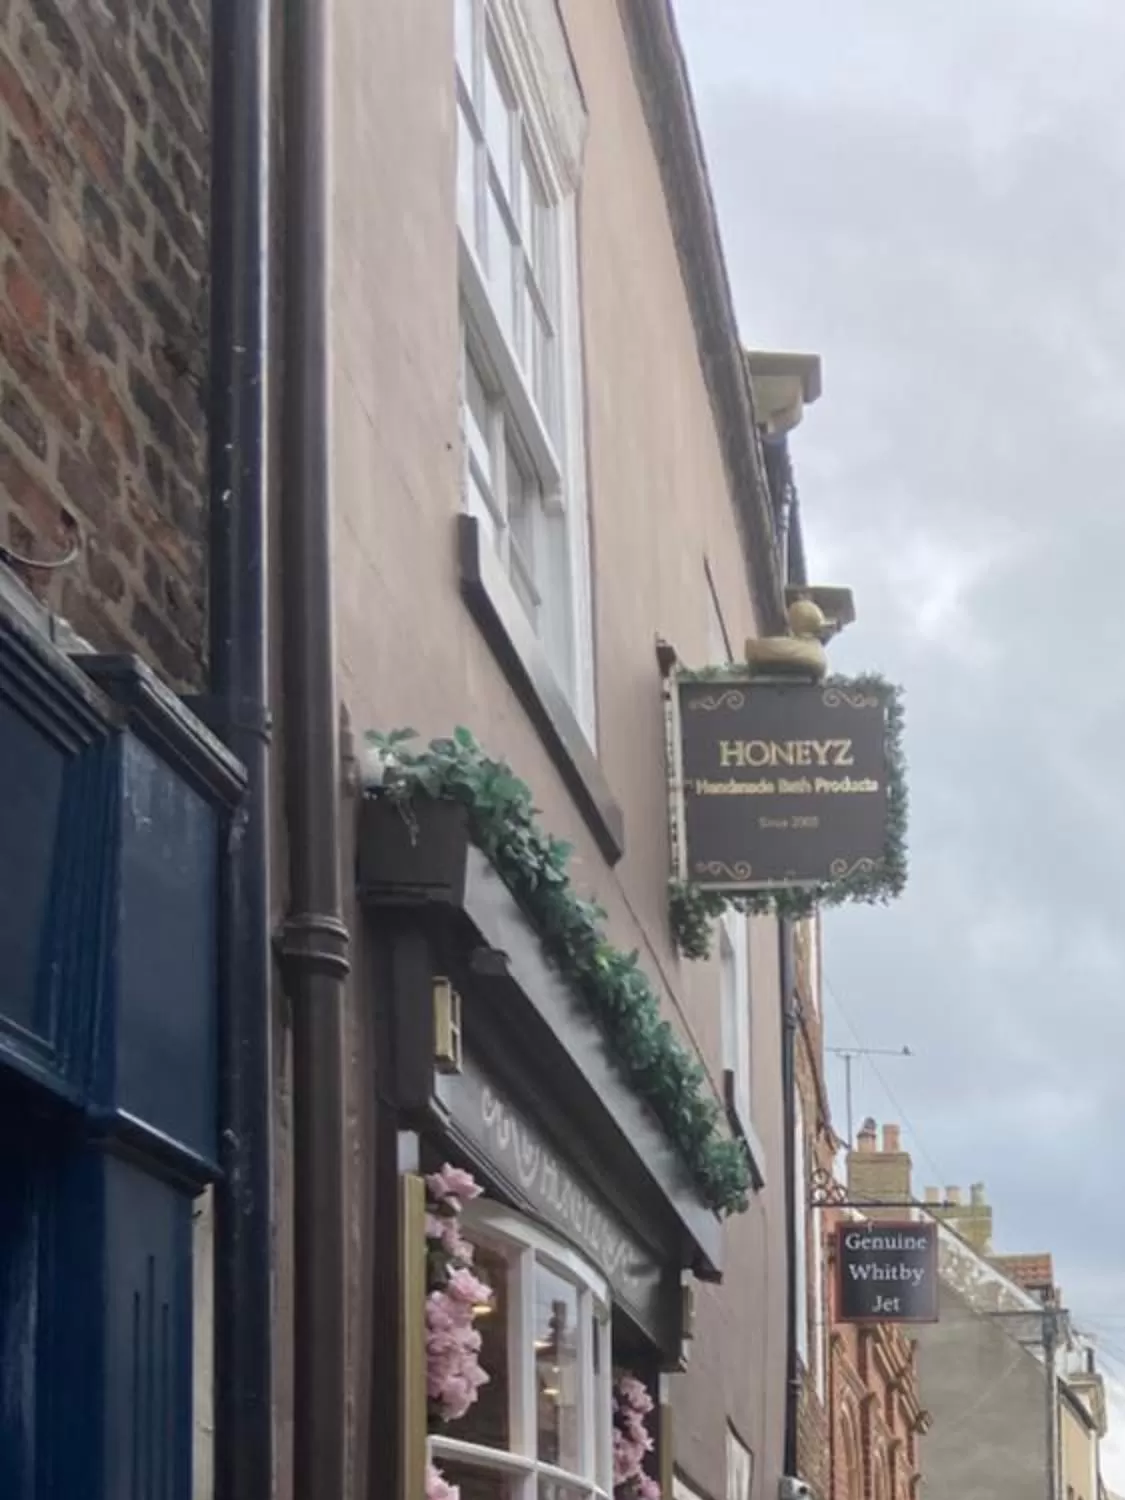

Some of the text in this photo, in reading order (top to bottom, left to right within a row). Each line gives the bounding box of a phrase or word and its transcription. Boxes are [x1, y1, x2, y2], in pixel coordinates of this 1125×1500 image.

[718, 738, 855, 767] HONEYZ
[696, 775, 879, 796] Handmade Bath Products
[844, 1232, 929, 1251] Genuine
[848, 1262, 926, 1287] Whitby
[871, 1295, 900, 1313] Jet
